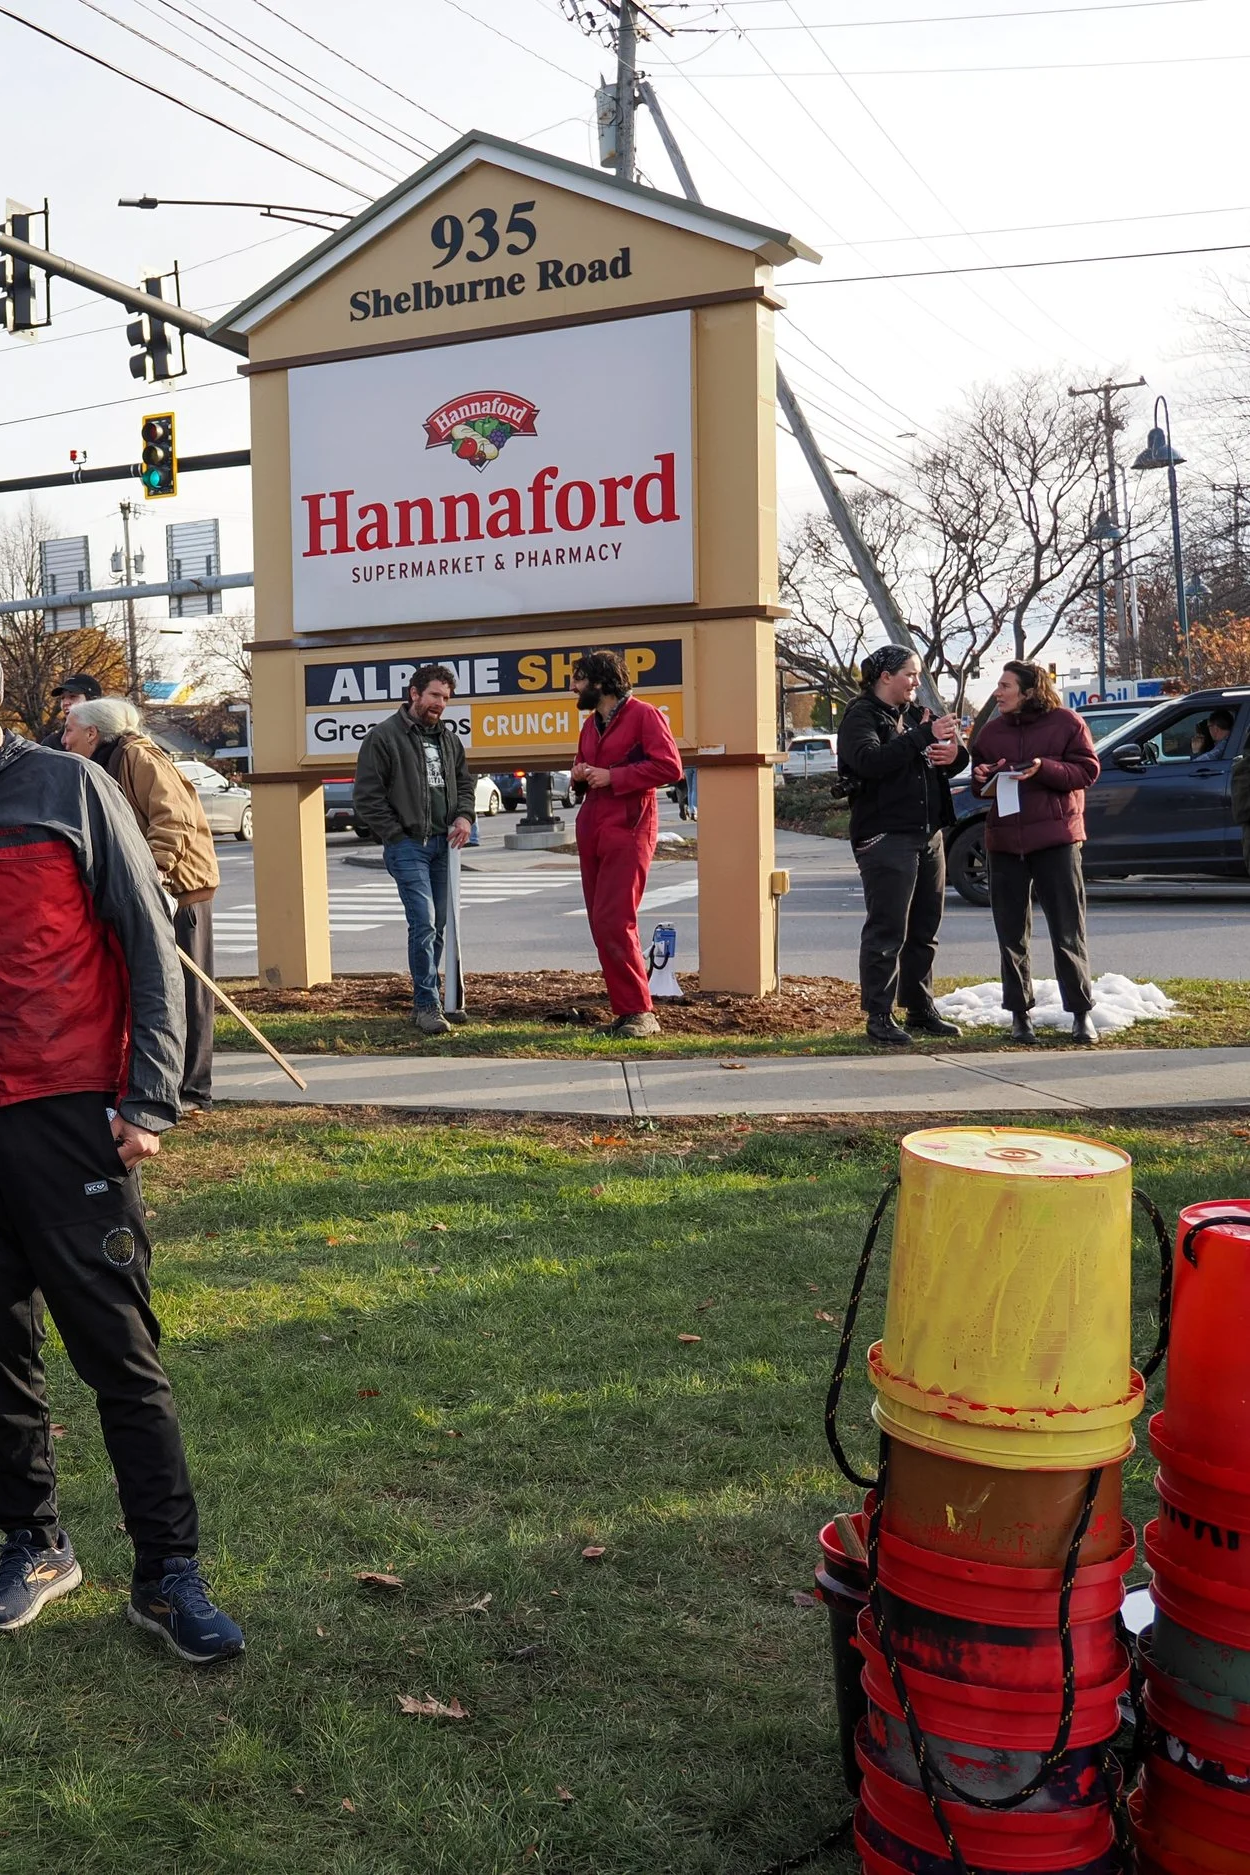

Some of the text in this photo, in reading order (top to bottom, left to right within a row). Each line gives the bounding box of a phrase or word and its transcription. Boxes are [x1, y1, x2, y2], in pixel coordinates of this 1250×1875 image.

[431, 200, 537, 270] 935
[350, 246, 632, 322] Shelburne Road
[434, 397, 528, 433] Hannaford
[301, 452, 680, 558] Hannaford
[351, 542, 623, 584] SUPERMARKET & PHARMACY
[329, 647, 657, 703] ALPNE SHP
[482, 711, 569, 737] CRUNCH
